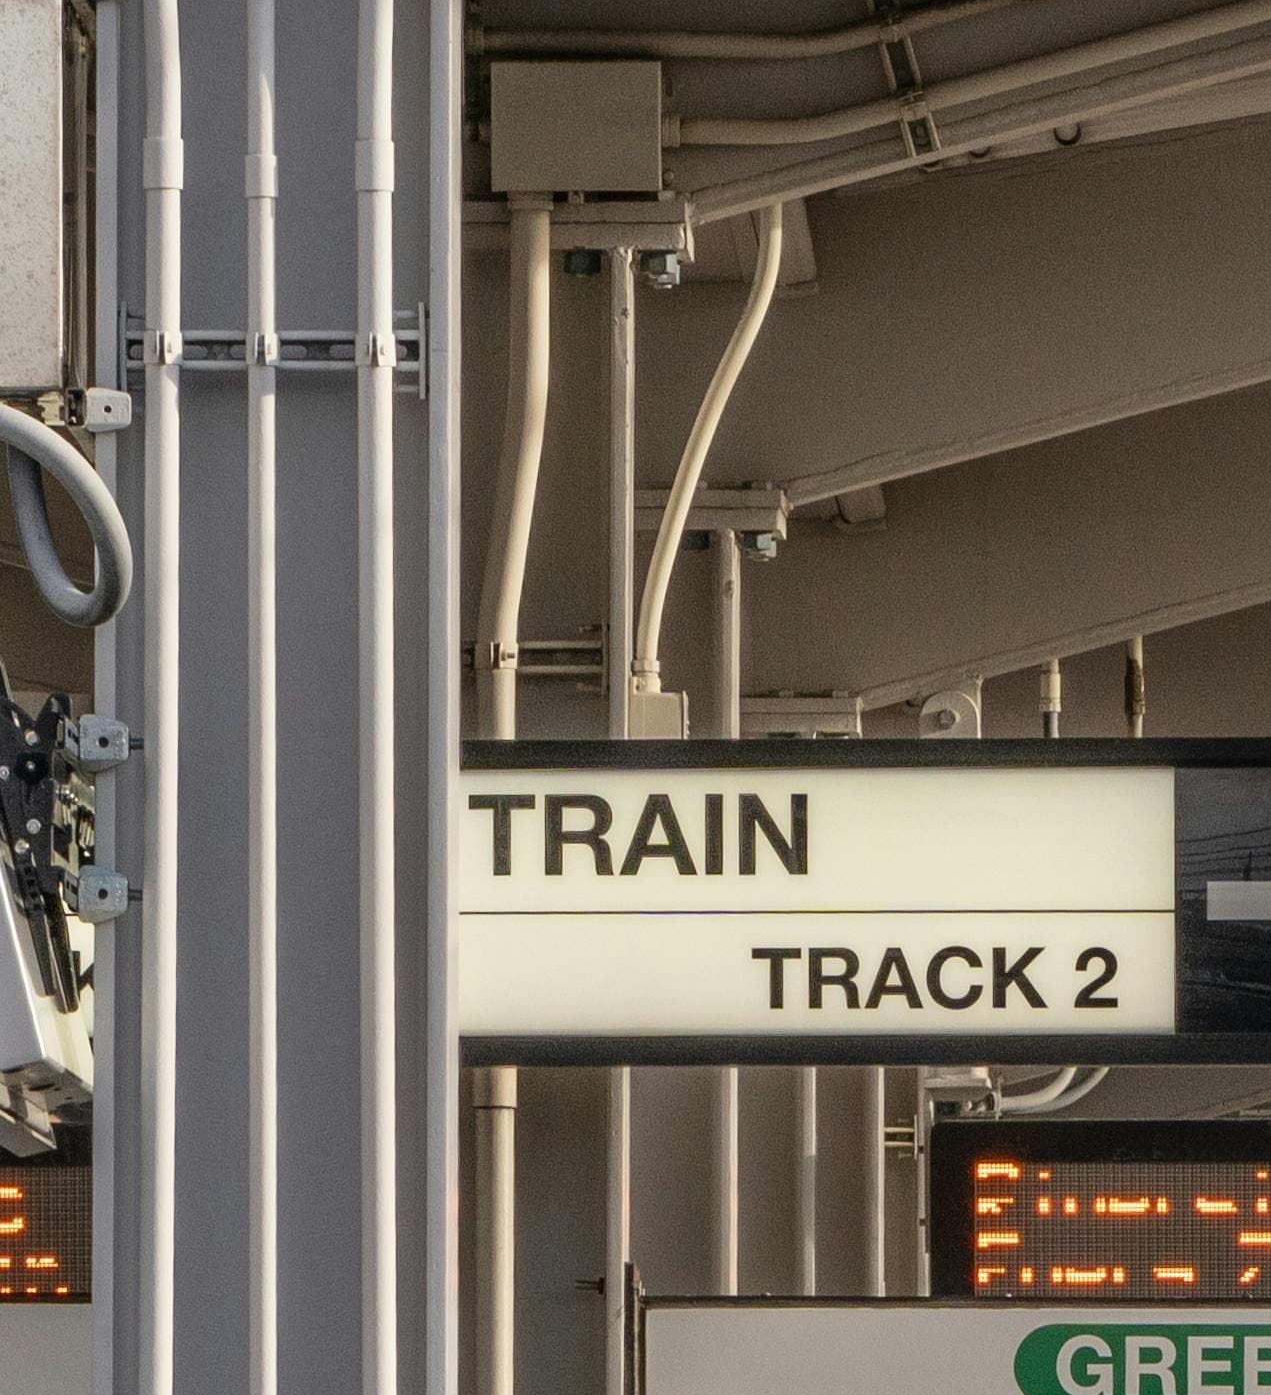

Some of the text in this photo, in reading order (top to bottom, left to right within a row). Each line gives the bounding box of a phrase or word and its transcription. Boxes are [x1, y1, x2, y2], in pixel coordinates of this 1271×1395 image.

[469, 793, 807, 876] TRAIN
[752, 945, 1119, 1010] TRACK 2
